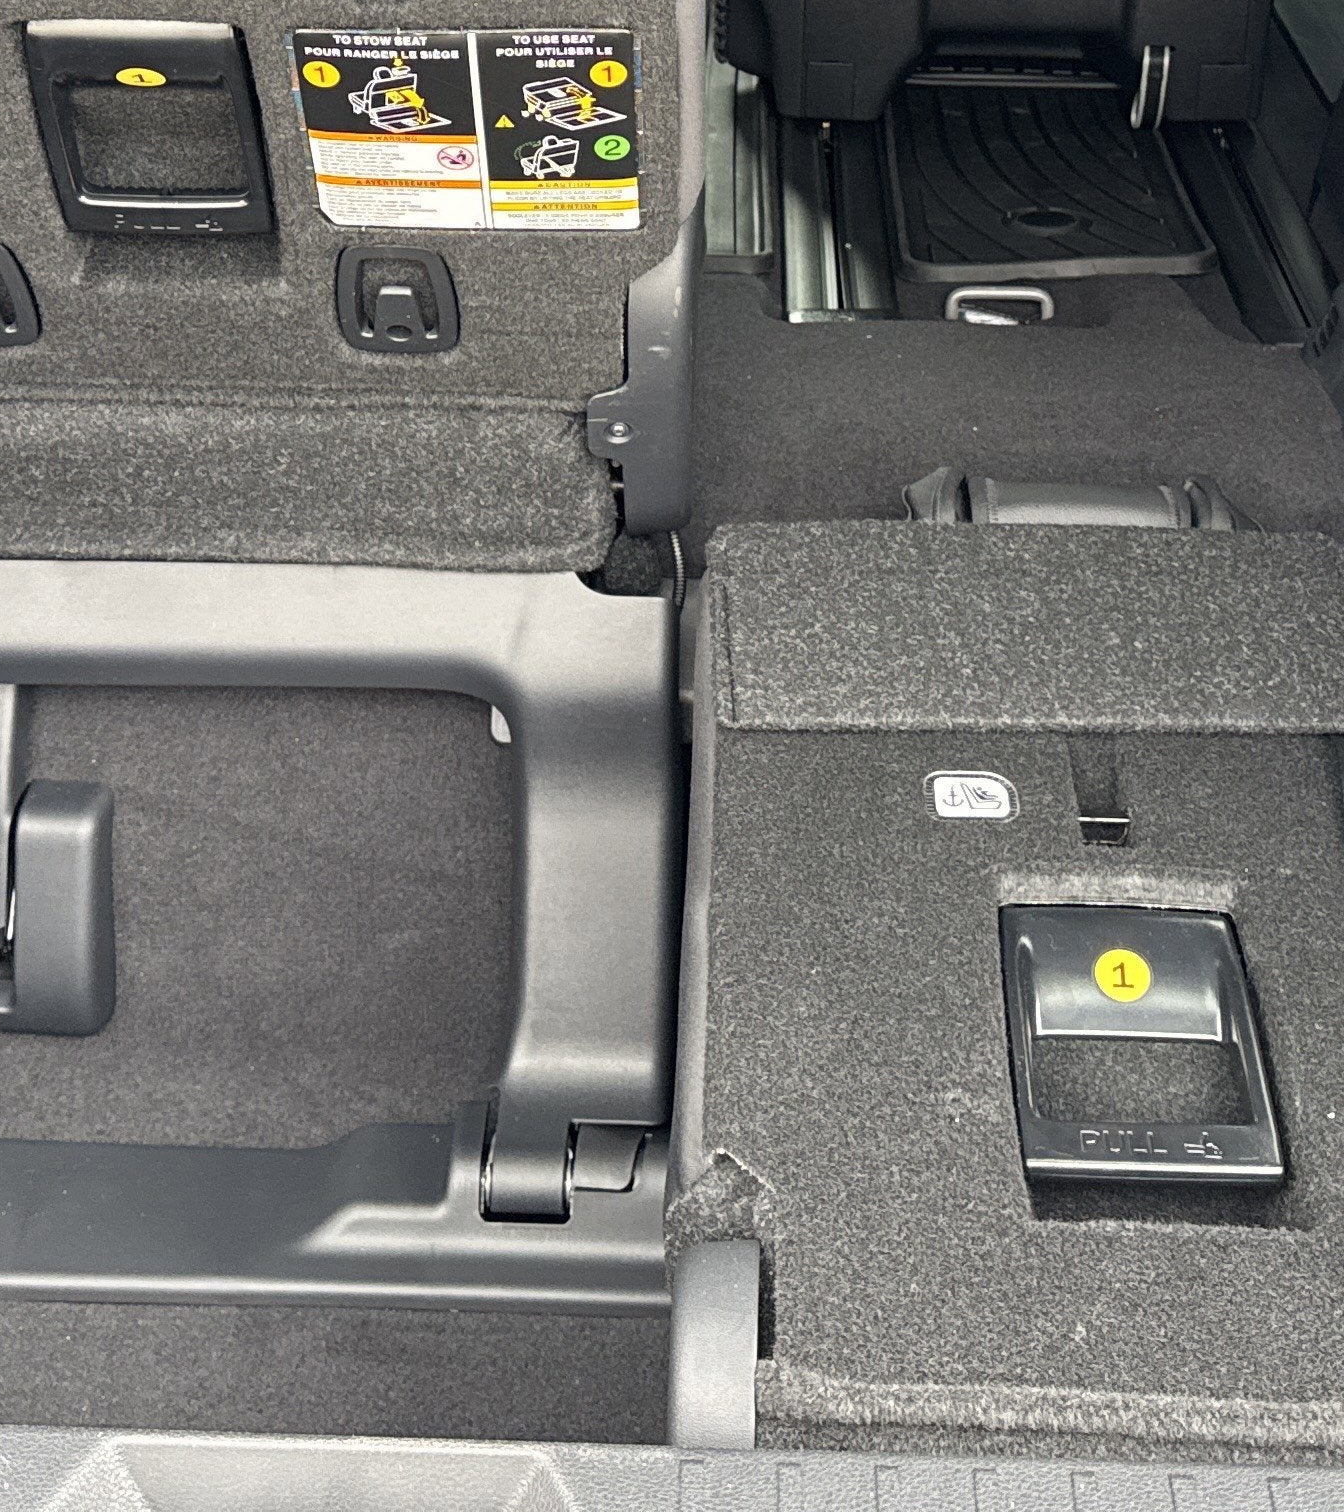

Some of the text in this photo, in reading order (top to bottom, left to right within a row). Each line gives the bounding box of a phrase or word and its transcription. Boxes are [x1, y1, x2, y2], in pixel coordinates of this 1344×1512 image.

[332, 34, 428, 47] TO STOW SEAT
[511, 34, 596, 45] TO USE SEAT
[304, 47, 341, 57] POUR
[343, 48, 399, 59] RANGER
[400, 50, 418, 60] LE
[496, 46, 614, 57] POUR UTILISER LE
[313, 65, 326, 83] 1
[601, 65, 613, 83] 1
[604, 138, 622, 156] 2
[1112, 961, 1135, 989] 1
[1079, 1129, 1168, 1154] PULL
